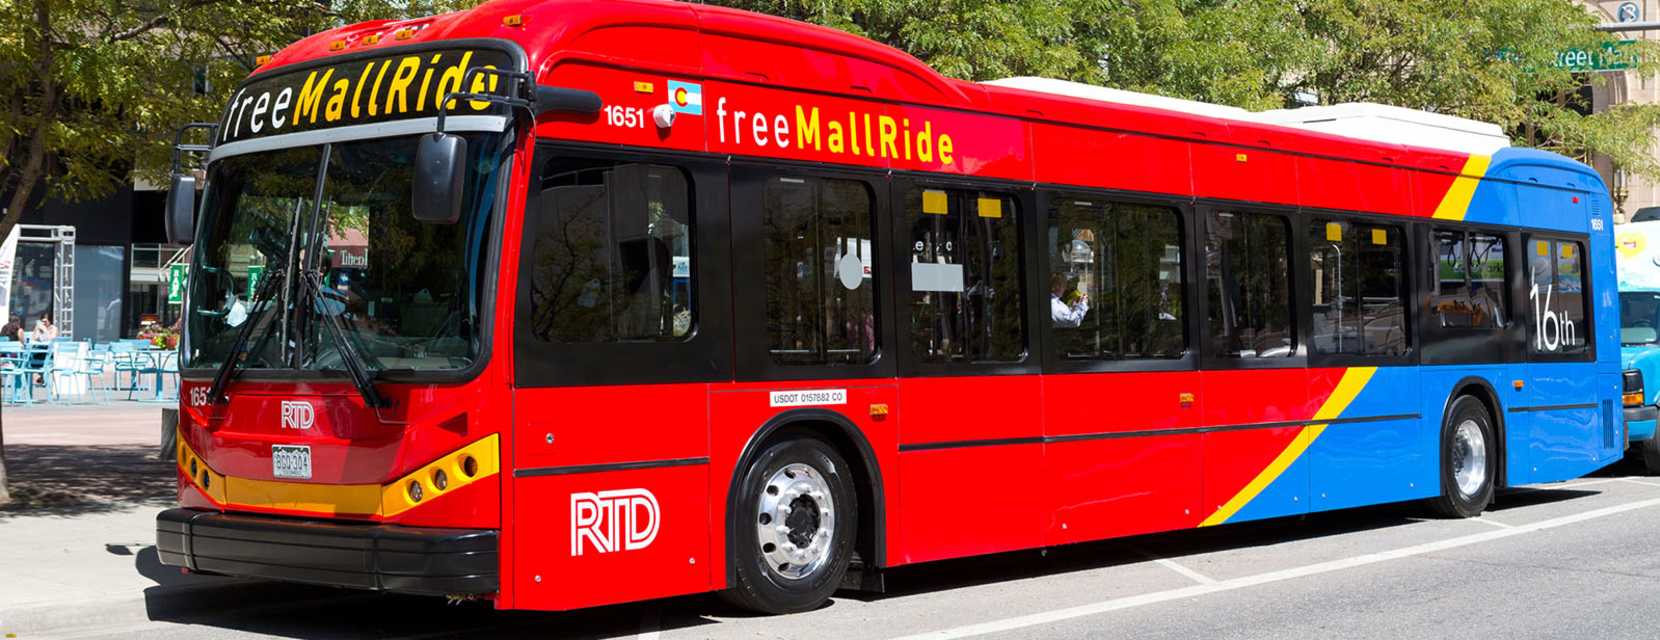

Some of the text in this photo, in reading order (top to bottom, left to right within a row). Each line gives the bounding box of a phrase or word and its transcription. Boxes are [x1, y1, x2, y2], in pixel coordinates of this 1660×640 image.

[604, 105, 644, 128] 1651
[716, 97, 953, 165] freeMallRide
[1529, 283, 1576, 351] 16th
[189, 387, 213, 406] 165
[774, 394, 798, 403] USDOT
[832, 392, 843, 401] CO
[281, 401, 315, 430] RTD
[570, 488, 661, 557] RTD
